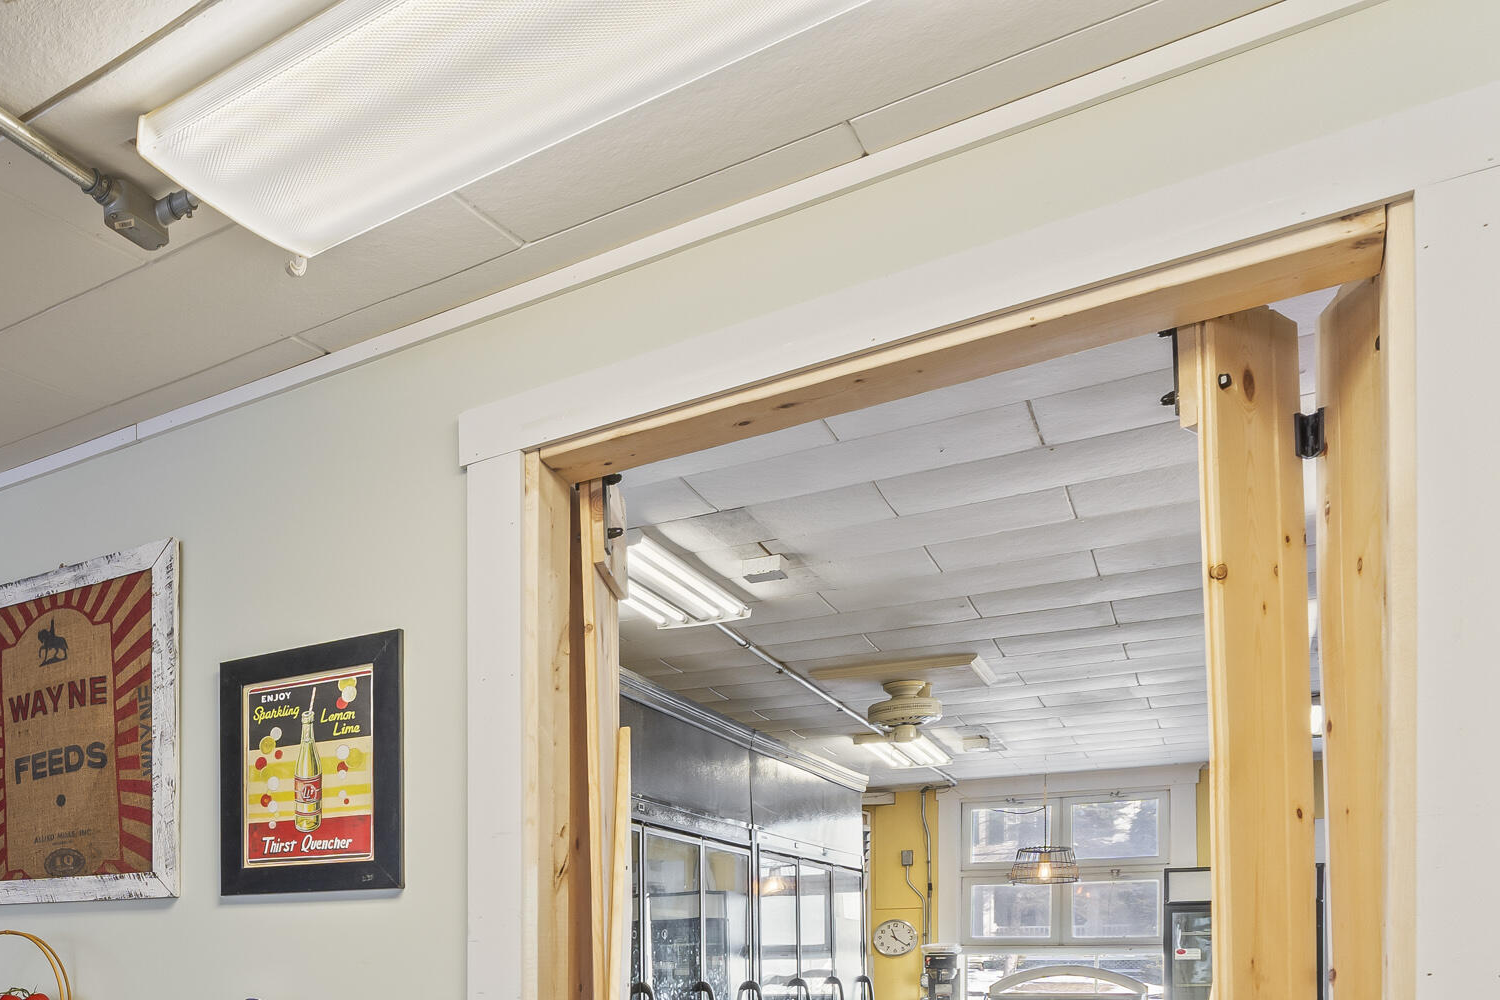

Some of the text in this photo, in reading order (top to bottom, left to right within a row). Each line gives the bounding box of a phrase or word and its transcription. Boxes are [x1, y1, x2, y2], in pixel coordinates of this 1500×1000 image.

[8, 675, 108, 723] WAYNE
[261, 691, 292, 703] ENJOY
[253, 704, 300, 725] Sparkling
[320, 708, 356, 724] Lemon
[332, 721, 361, 736] Lime
[14, 741, 108, 785] FEEDS
[261, 834, 353, 855] Thirst Quencher
